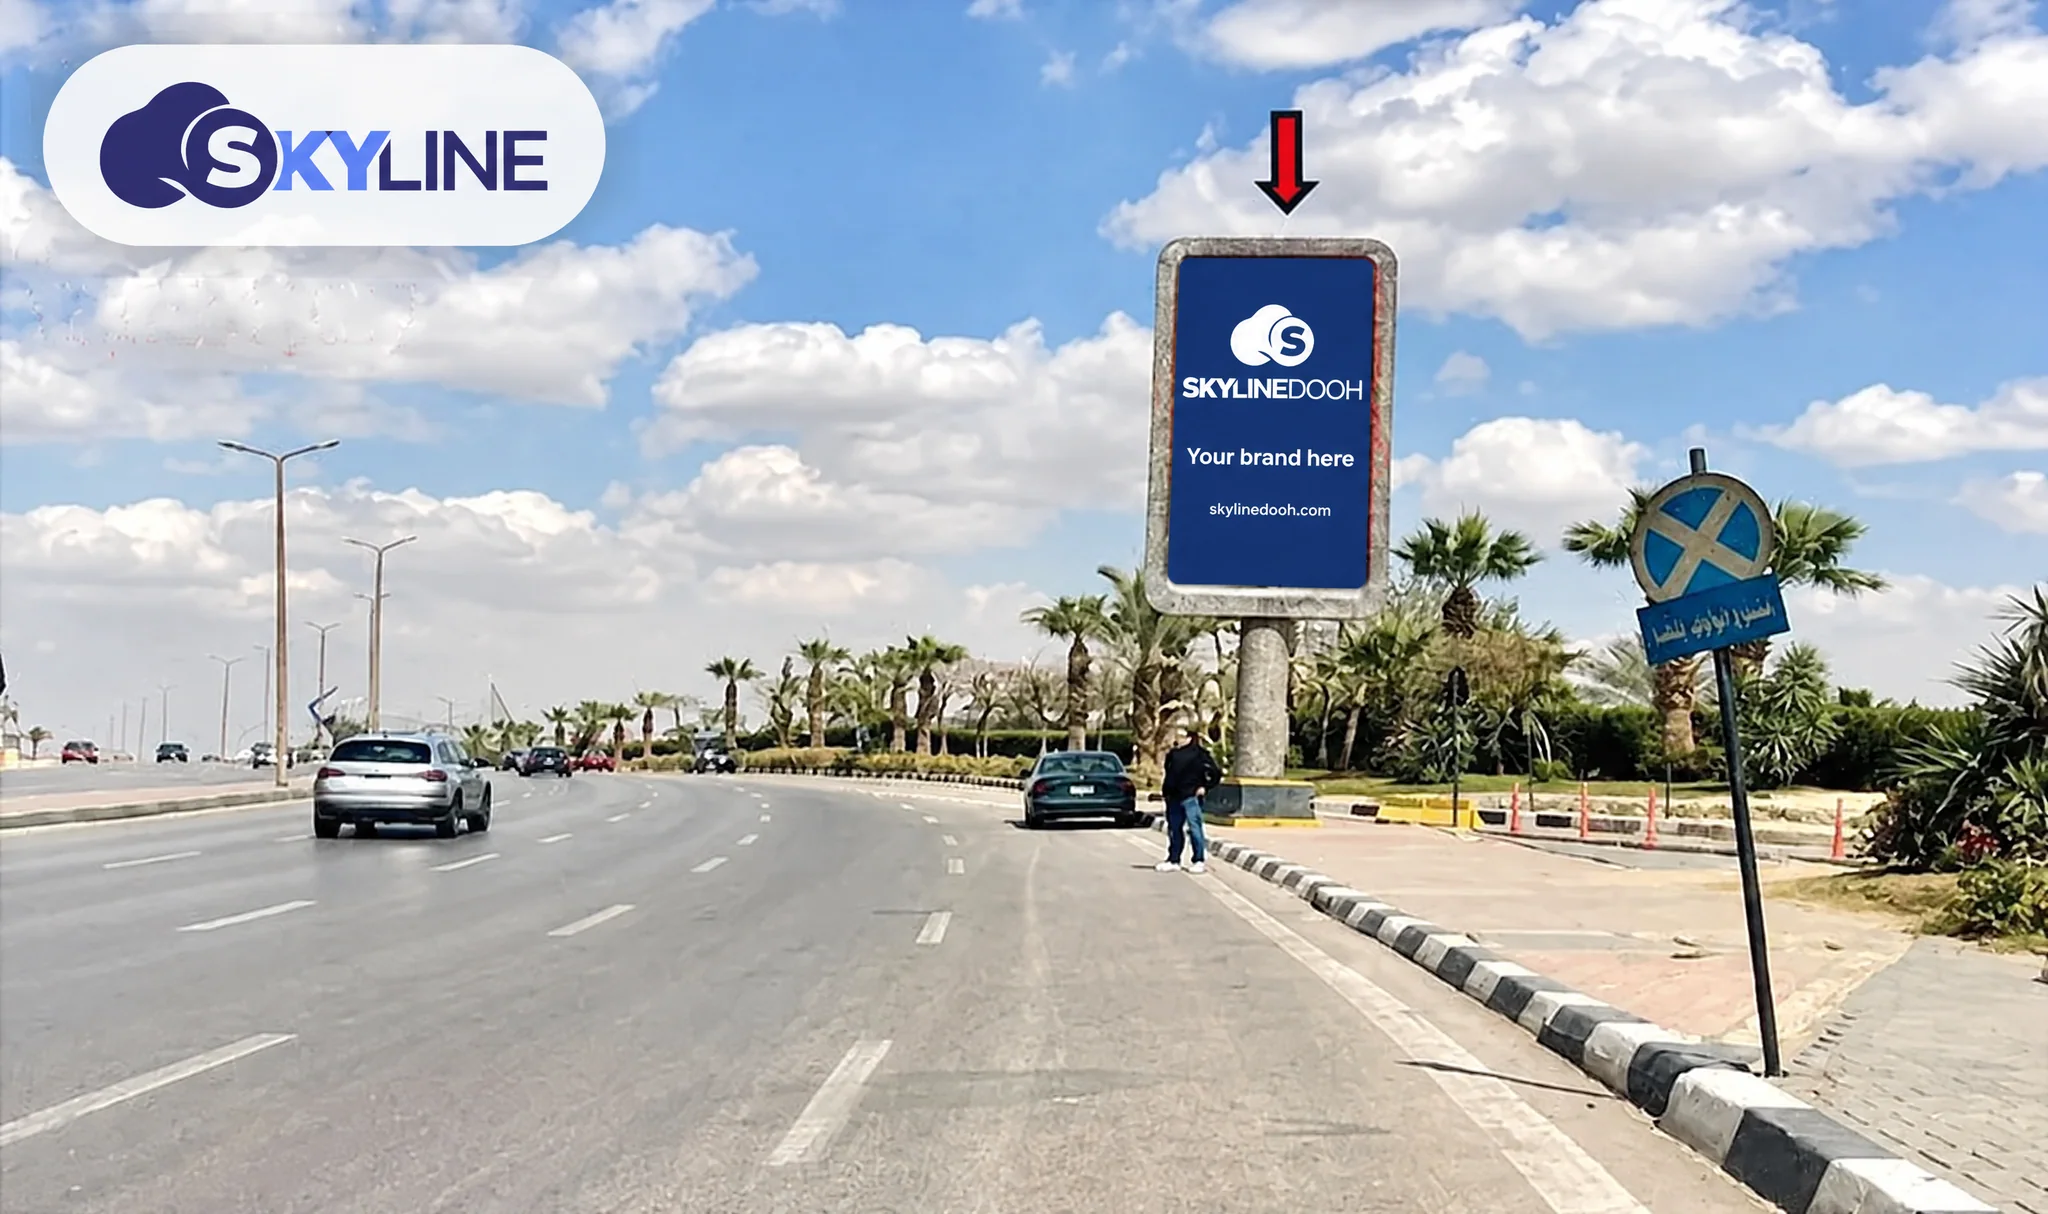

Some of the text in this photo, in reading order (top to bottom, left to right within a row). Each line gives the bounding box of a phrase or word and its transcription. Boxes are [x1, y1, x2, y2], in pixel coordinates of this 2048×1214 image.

[1181, 376, 1363, 401] SKYLINEDOOH
[1186, 447, 1355, 468] Your brand here
[1208, 502, 1331, 518] skylinedooh.com
